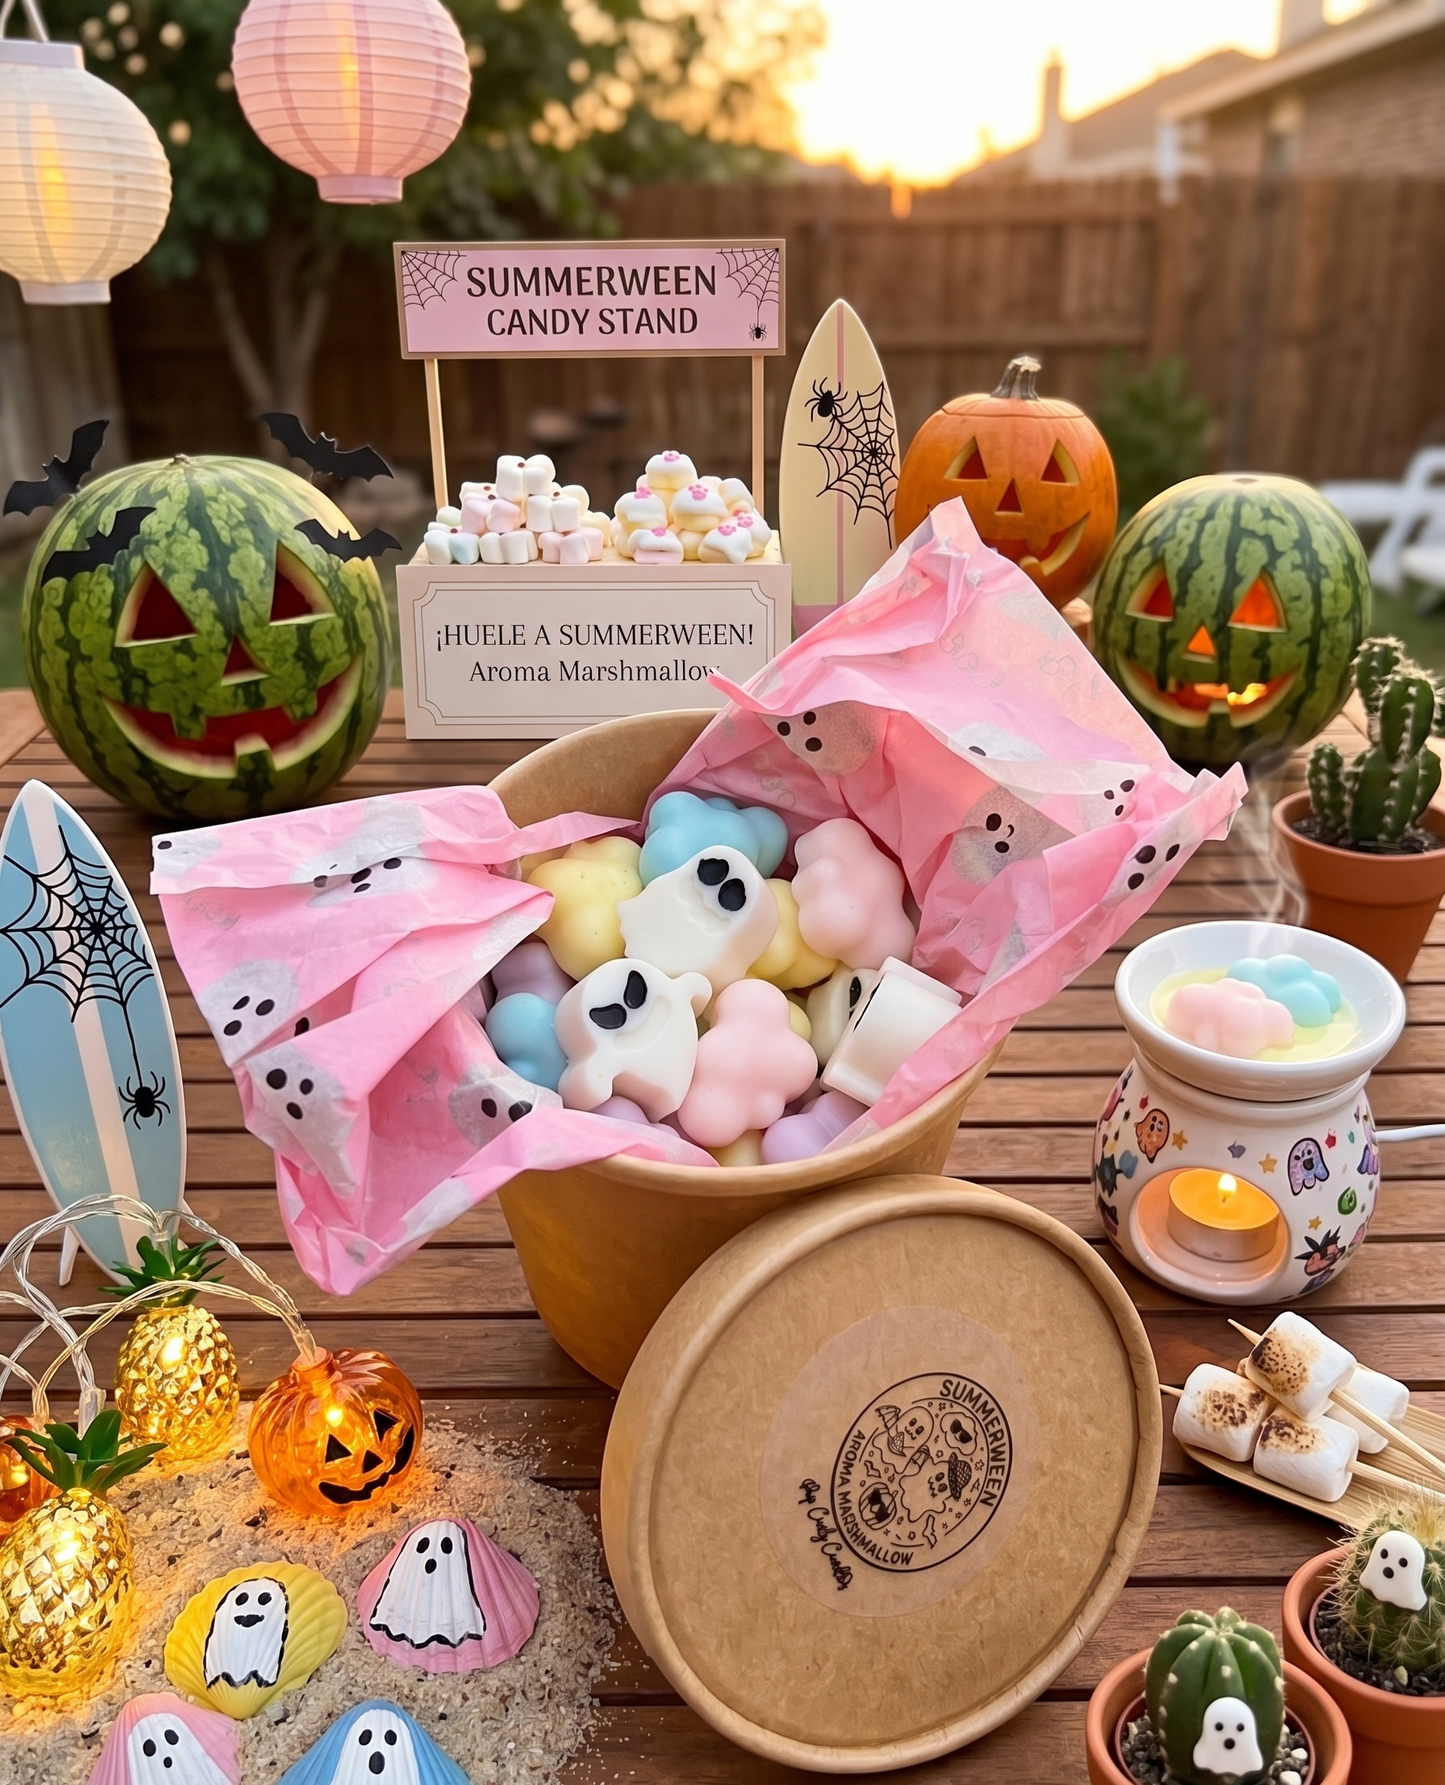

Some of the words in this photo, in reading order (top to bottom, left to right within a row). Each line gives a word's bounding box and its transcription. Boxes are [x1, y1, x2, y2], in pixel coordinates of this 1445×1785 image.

[467, 265, 716, 297] SUMMERWEEN
[487, 308, 590, 335] CANDY
[598, 307, 698, 334] STAND
[436, 624, 526, 652] ¡HUELE
[533, 624, 552, 646] A
[559, 623, 753, 646] SUMMERWEEN!
[469, 660, 552, 682] Aroma
[838, 1429, 866, 1488] AROMA
[939, 1379, 1006, 1507] SUMMERWEEN
[838, 1490, 914, 1566] MARSHMALLOW
